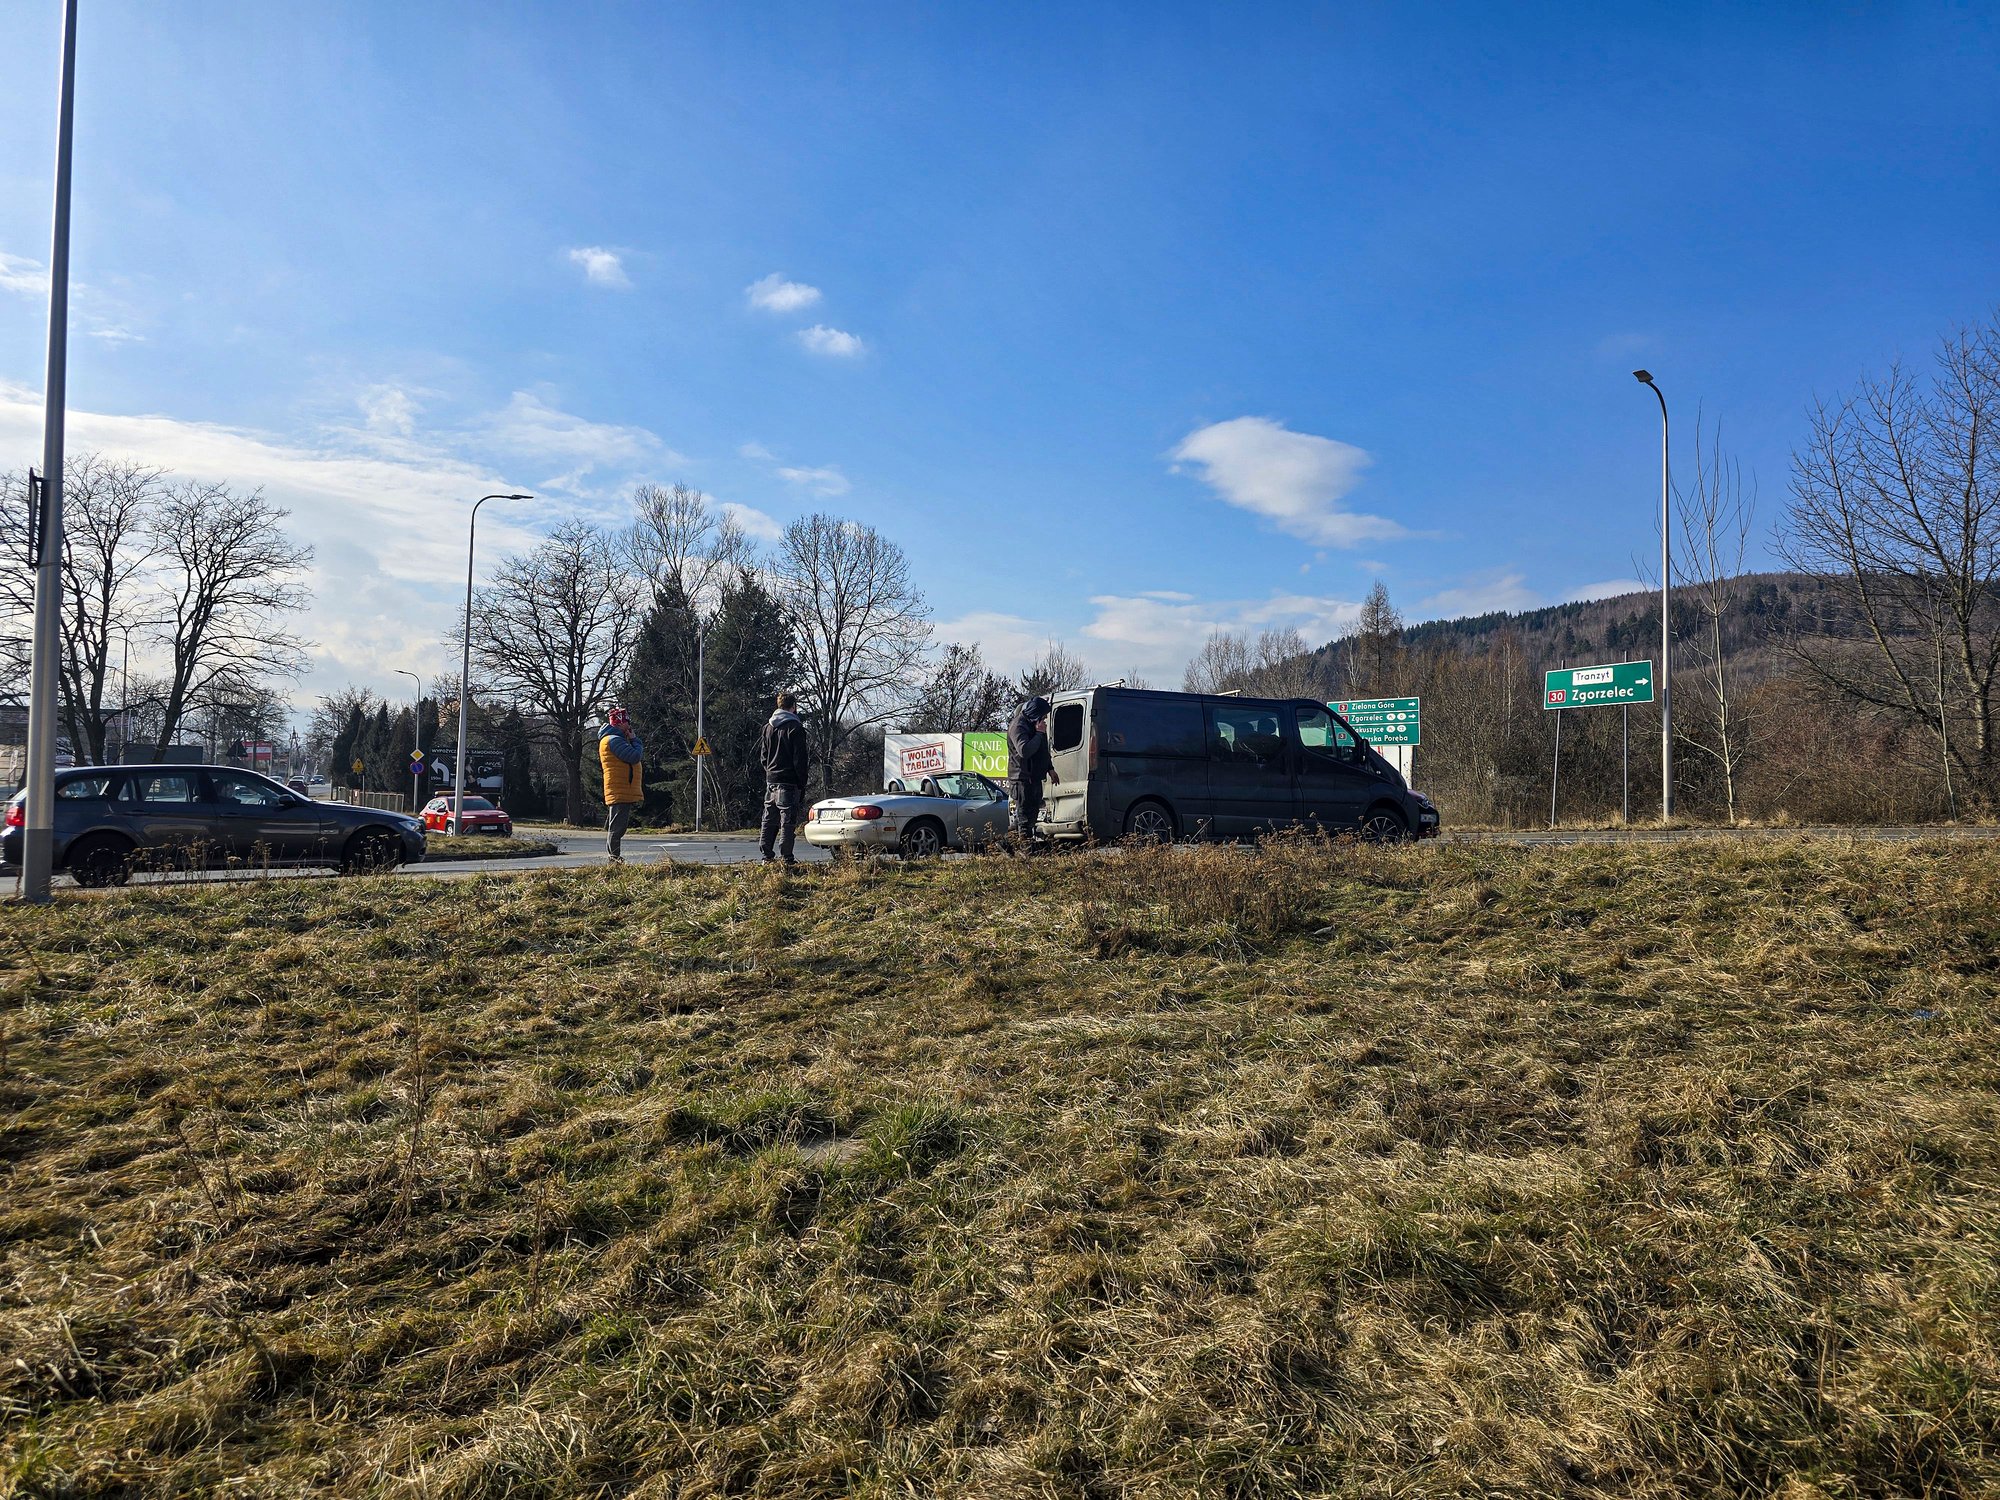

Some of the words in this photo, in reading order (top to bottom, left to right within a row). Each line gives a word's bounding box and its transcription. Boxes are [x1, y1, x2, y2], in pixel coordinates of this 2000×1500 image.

[1576, 671, 1610, 681] Tranzyt
[1551, 692, 1563, 701] 30
[1572, 686, 1634, 703] Zgorzelec
[1377, 701, 1395, 709] Góra
[1351, 713, 1383, 723] Zgorzelec
[1384, 734, 1408, 743] Poręba
[972, 740, 1002, 752] TANIE
[907, 748, 938, 761] WOLNA
[906, 758, 941, 771] TABLICA
